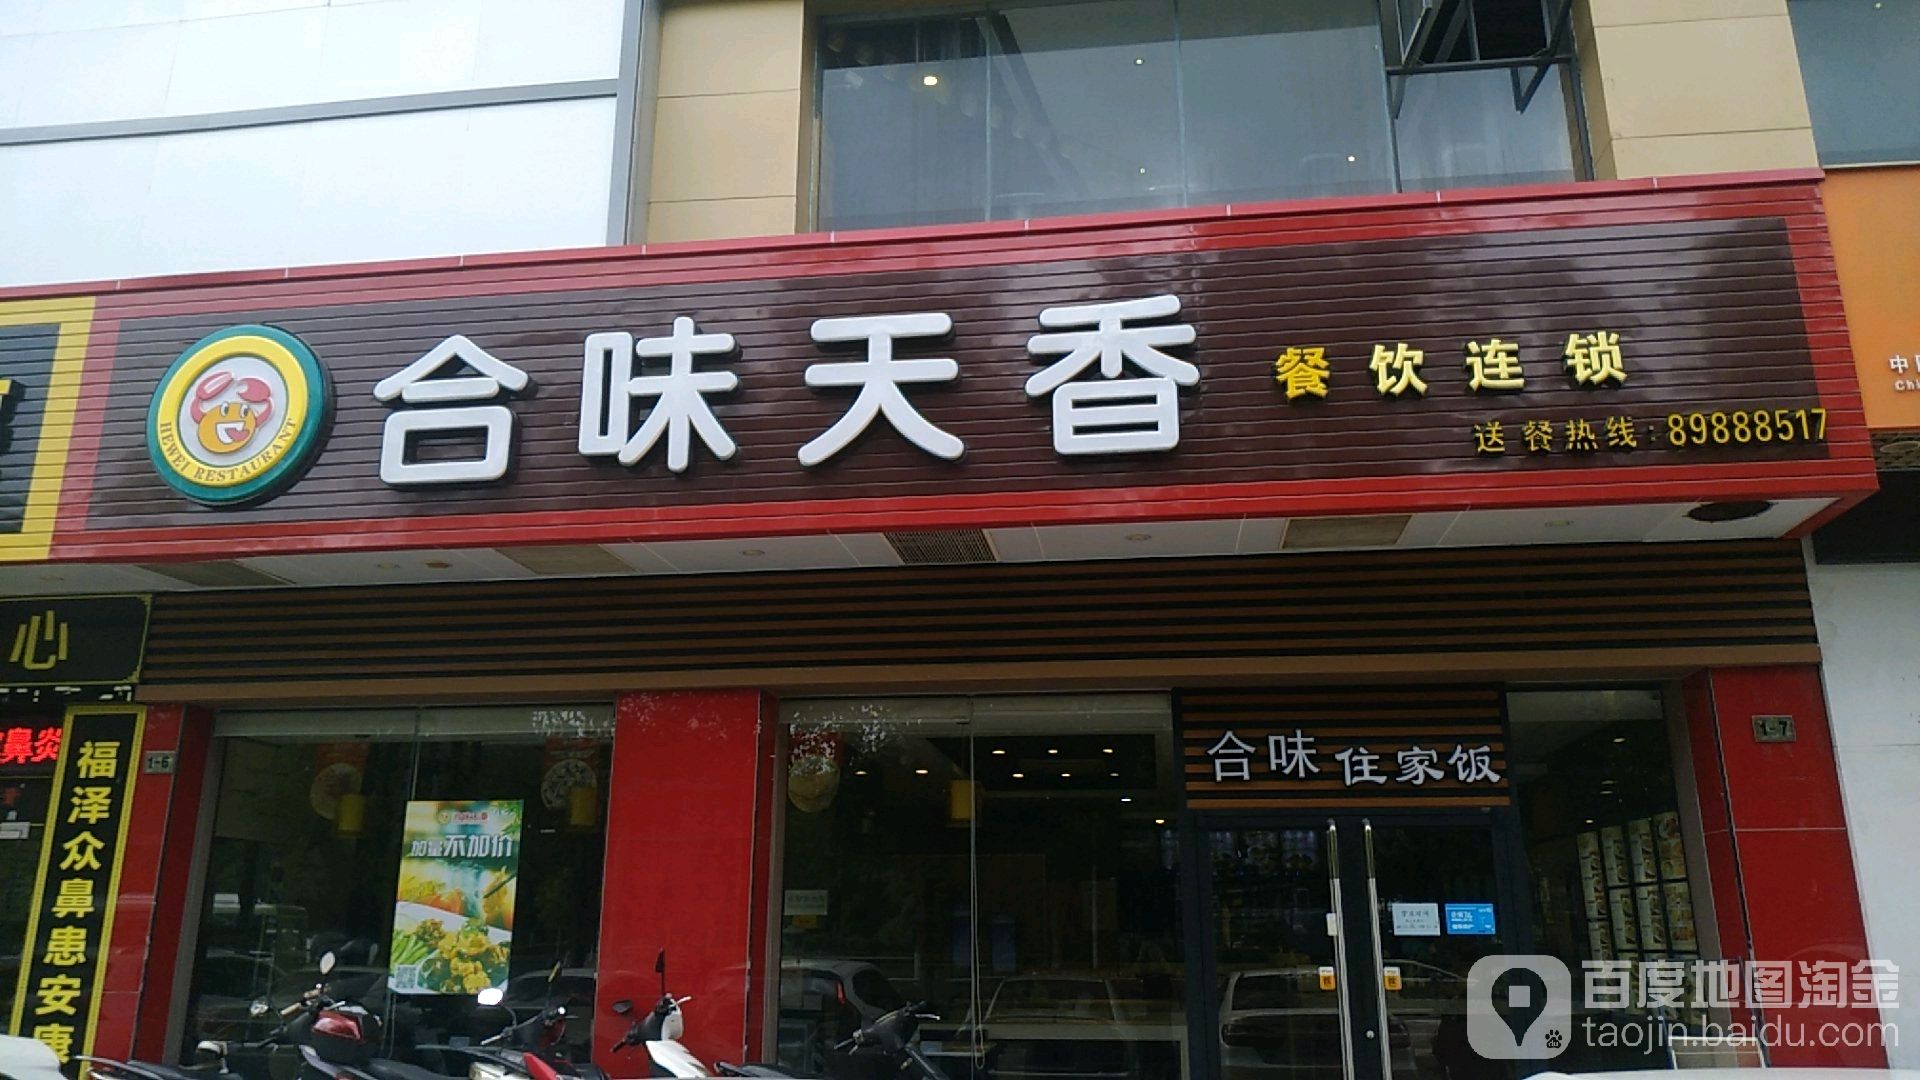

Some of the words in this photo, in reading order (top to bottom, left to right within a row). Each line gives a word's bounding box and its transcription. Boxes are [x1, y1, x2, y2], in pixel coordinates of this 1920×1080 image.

[373, 295, 1200, 485] 合味天香
[1275, 331, 1627, 399] 餐饮连锁
[160, 421, 191, 474] HEWEI
[193, 418, 297, 483] RESTAURANT
[8, 609, 69, 670] 心
[0, 727, 62, 764] 鼻炎
[1760, 719, 1788, 737] 1-7
[148, 755, 170, 769] 1-6
[1206, 729, 1501, 786] 合味住家饭
